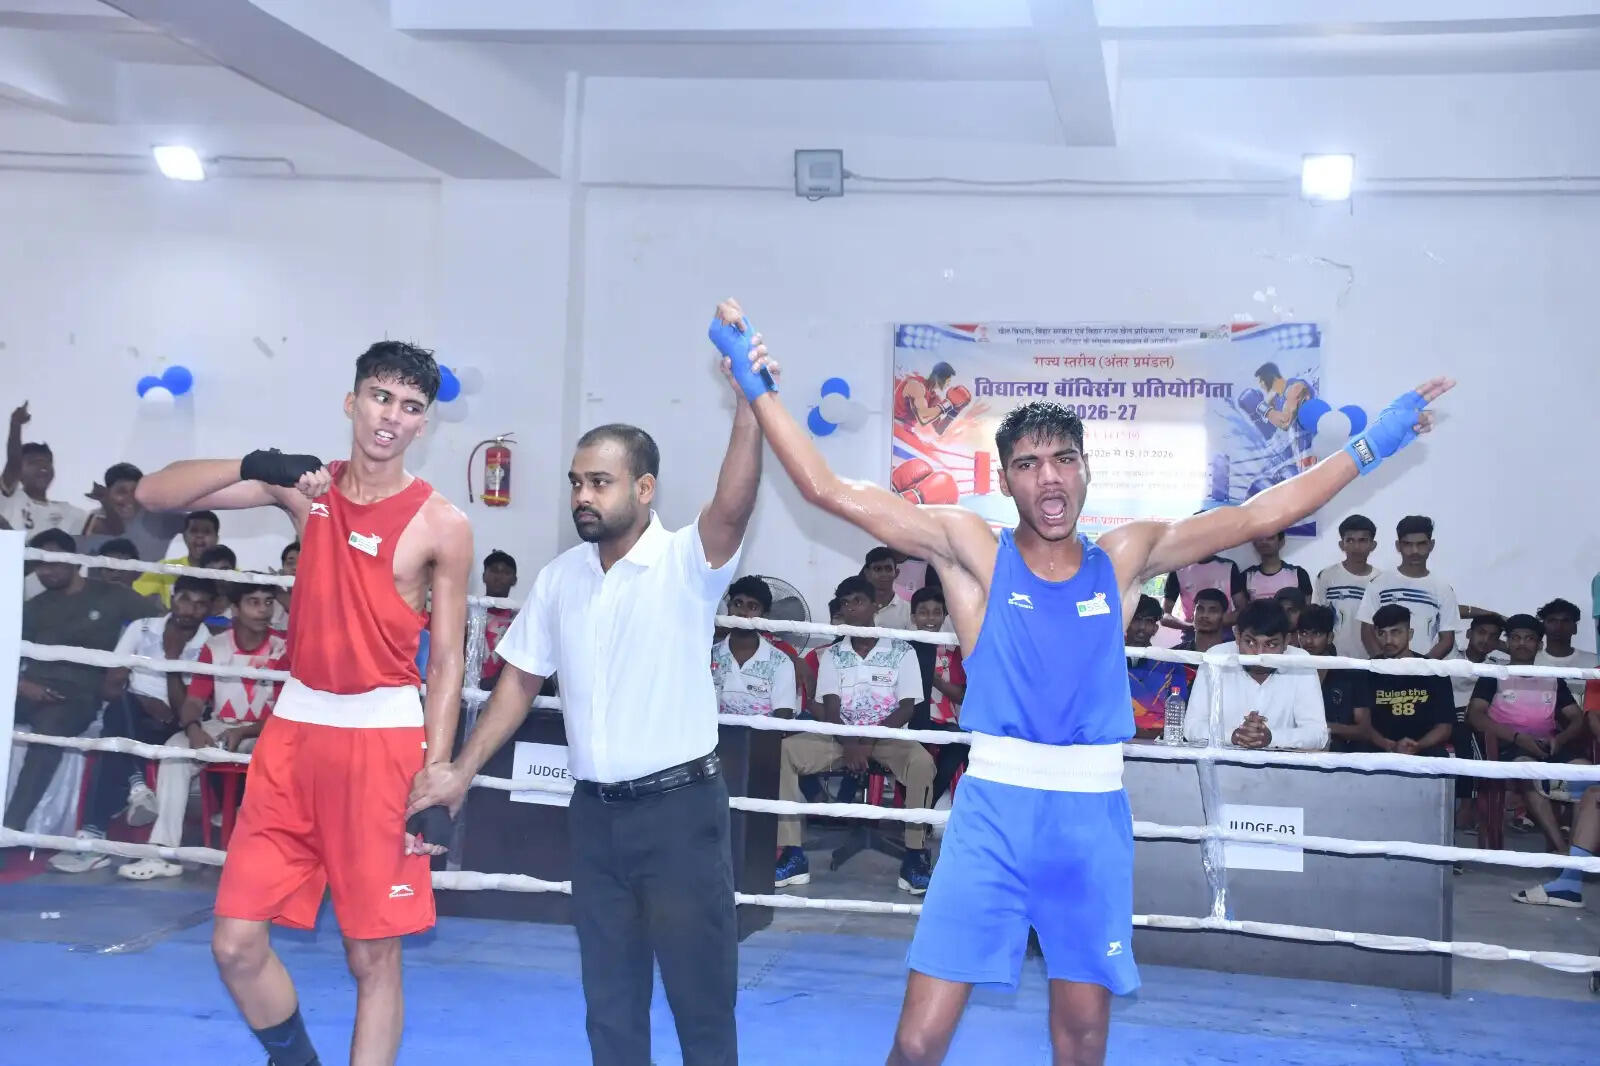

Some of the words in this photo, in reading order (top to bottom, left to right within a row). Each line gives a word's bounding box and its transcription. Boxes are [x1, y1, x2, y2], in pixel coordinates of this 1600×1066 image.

[1034, 356, 1060, 368] राज्य
[1064, 353, 1096, 368] स्तरीय
[1099, 354, 1129, 369] (अंतर
[1133, 354, 1175, 369] प्रमंडल)
[975, 377, 1049, 397] विद्यालय
[1054, 377, 1126, 398] बॉक्सिंग
[1132, 377, 1234, 398] प्रतियोगिता
[1392, 703, 1415, 715] 88
[527, 764, 572, 779] JUDGE-
[1230, 820, 1295, 835] JUDGE-03
